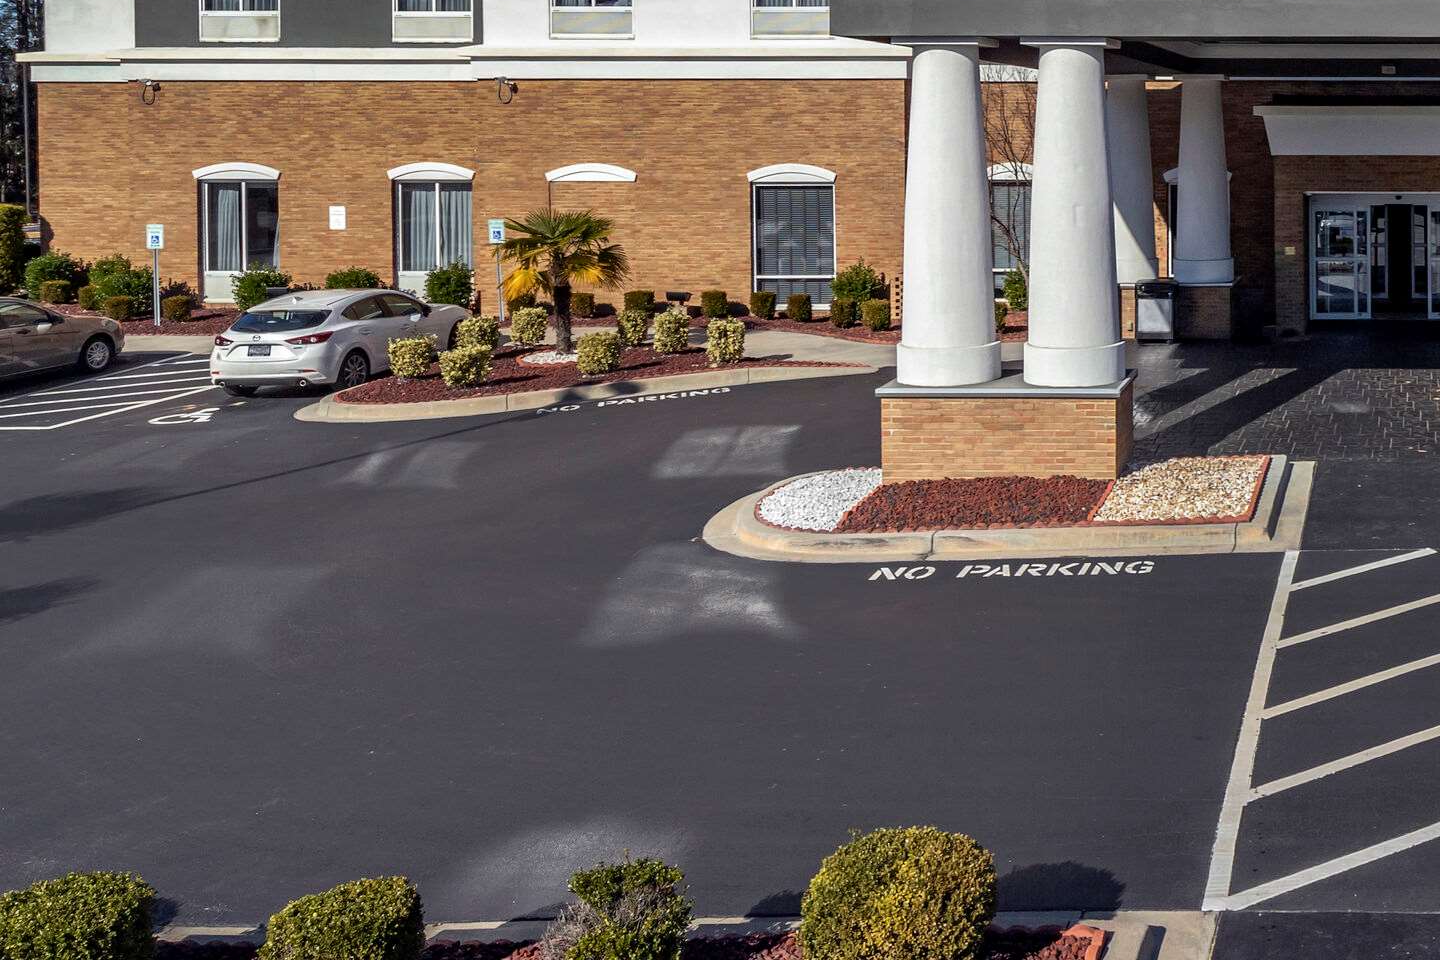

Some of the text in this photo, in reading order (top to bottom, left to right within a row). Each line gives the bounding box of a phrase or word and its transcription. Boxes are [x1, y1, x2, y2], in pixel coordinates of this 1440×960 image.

[536, 387, 732, 416] NO PARKING
[868, 560, 1155, 581] NO PARKING
